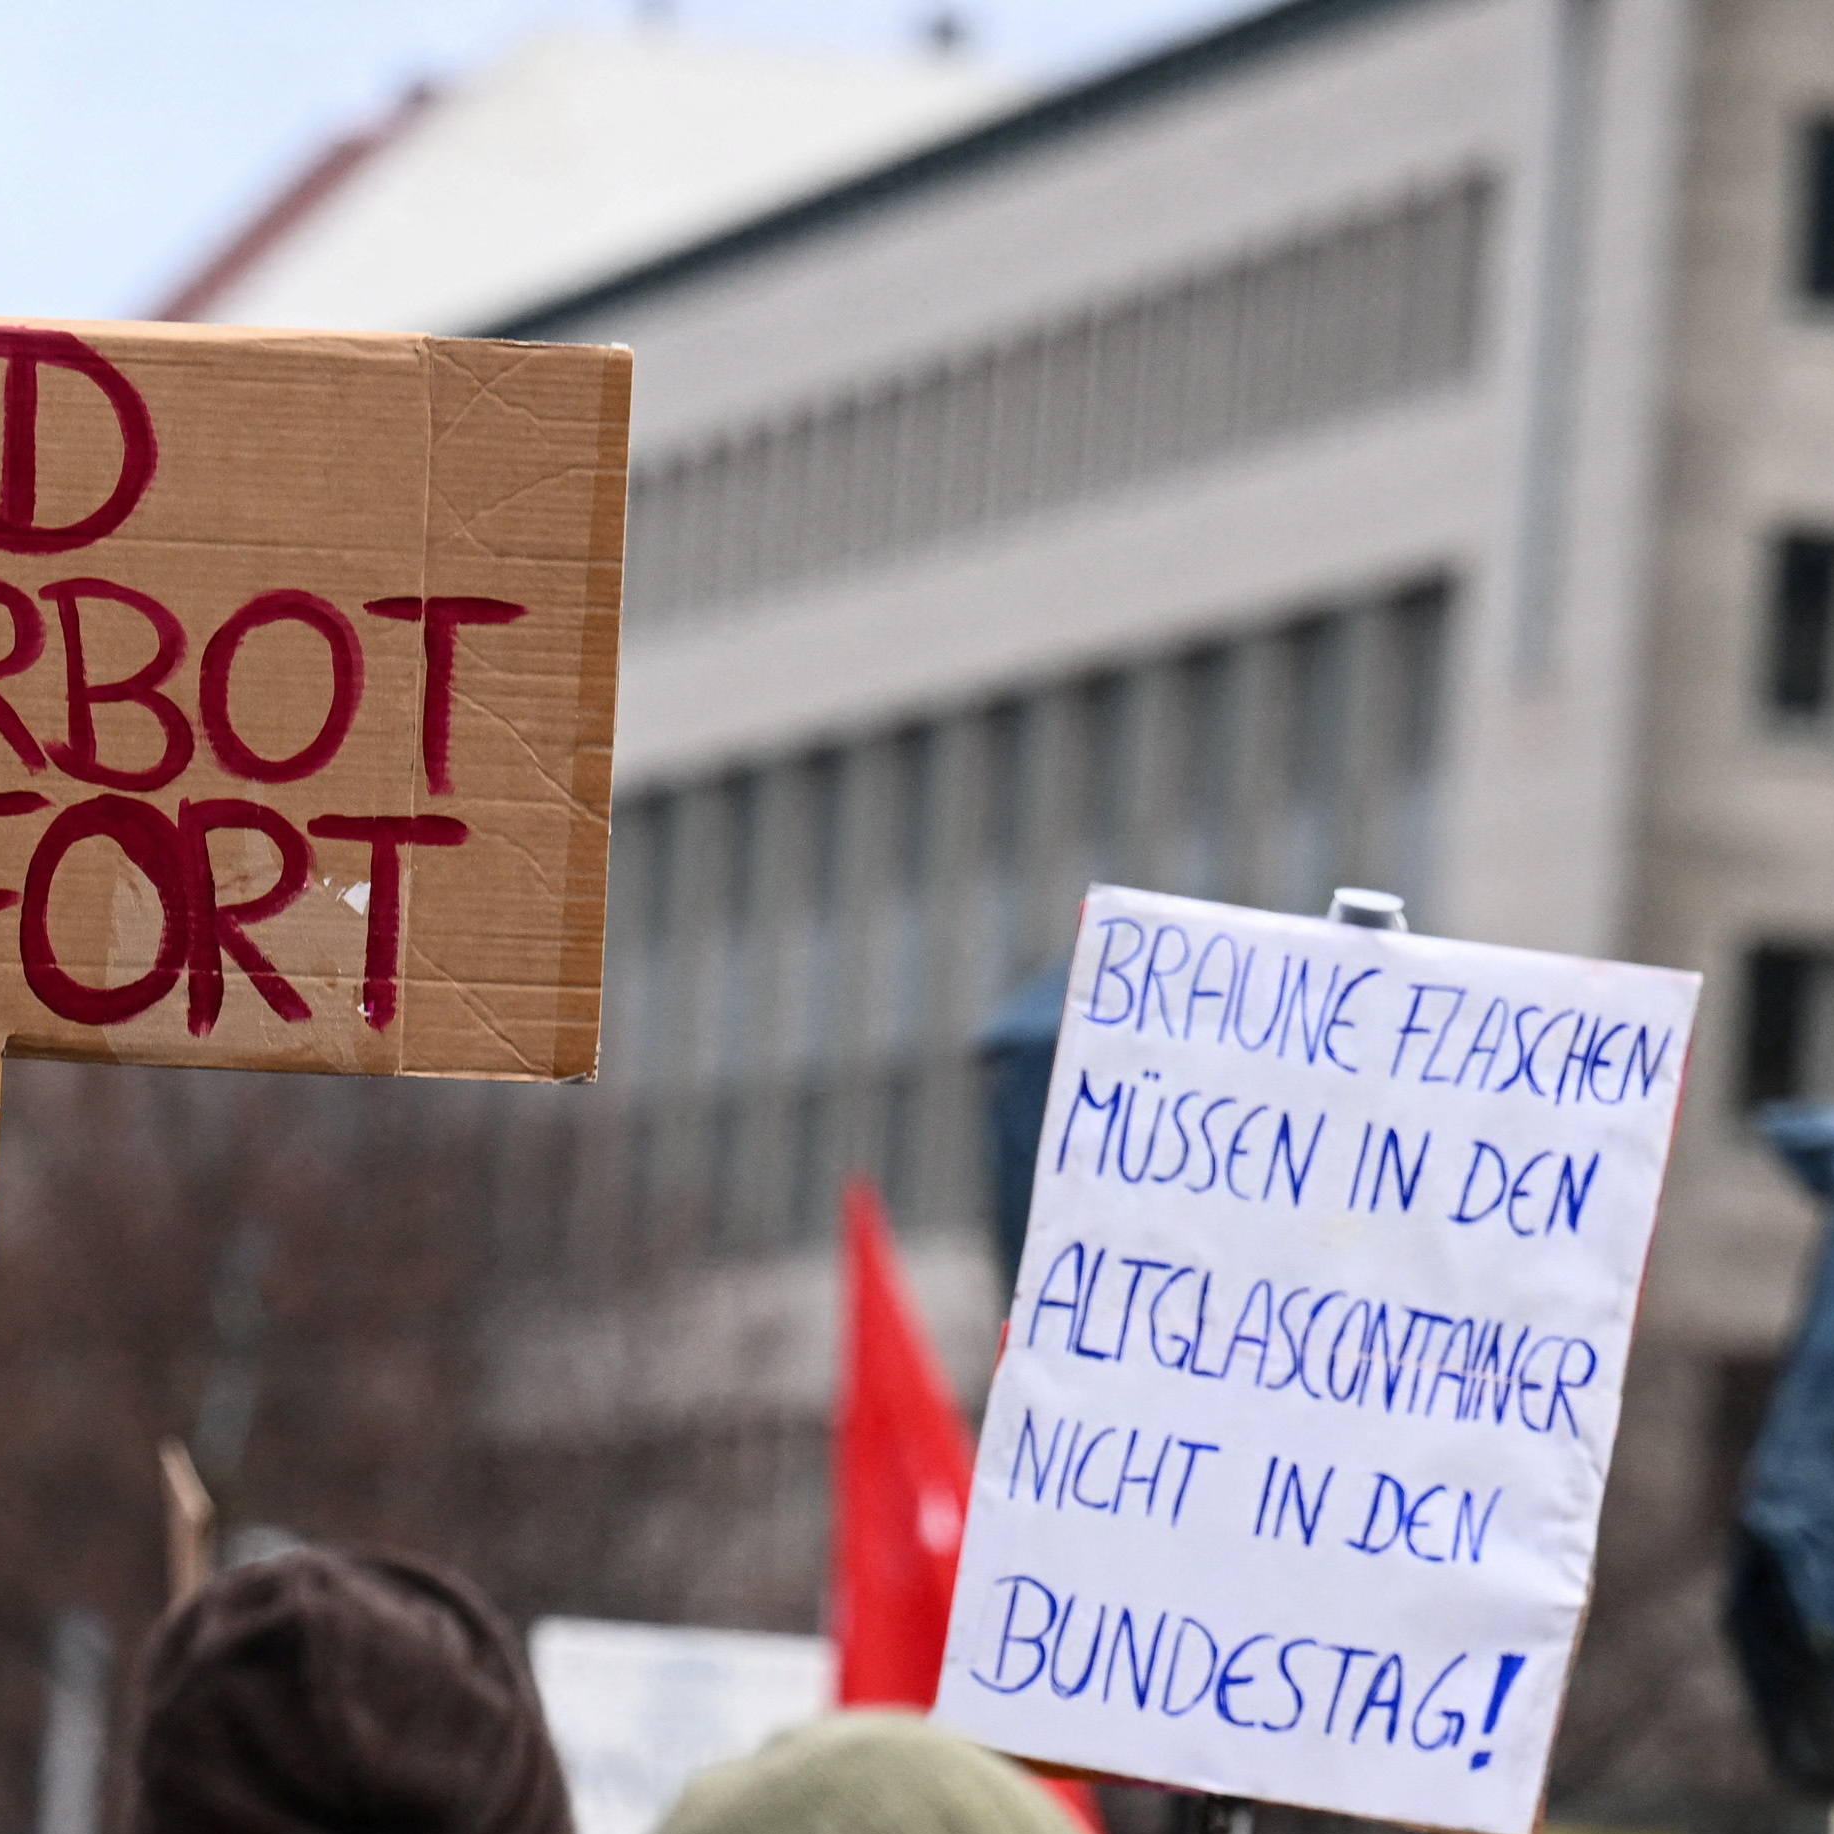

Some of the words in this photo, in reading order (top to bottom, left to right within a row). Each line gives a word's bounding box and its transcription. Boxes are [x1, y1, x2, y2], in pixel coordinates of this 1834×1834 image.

[1080, 916, 1382, 1075] BRAUNE
[1389, 982, 1673, 1106] FLASCHEN
[1054, 1069, 1326, 1208] MÜSSEN
[1347, 1122, 1431, 1213] IN
[1446, 1140, 1600, 1238] DEN
[1026, 1240, 1598, 1440] ALTGLASCONTAINER
[1007, 1407, 1221, 1529] NICHT
[1254, 1456, 1336, 1548] IN
[1345, 1470, 1502, 1565] DEN
[970, 1574, 1526, 1772] BUNDESTAG!
